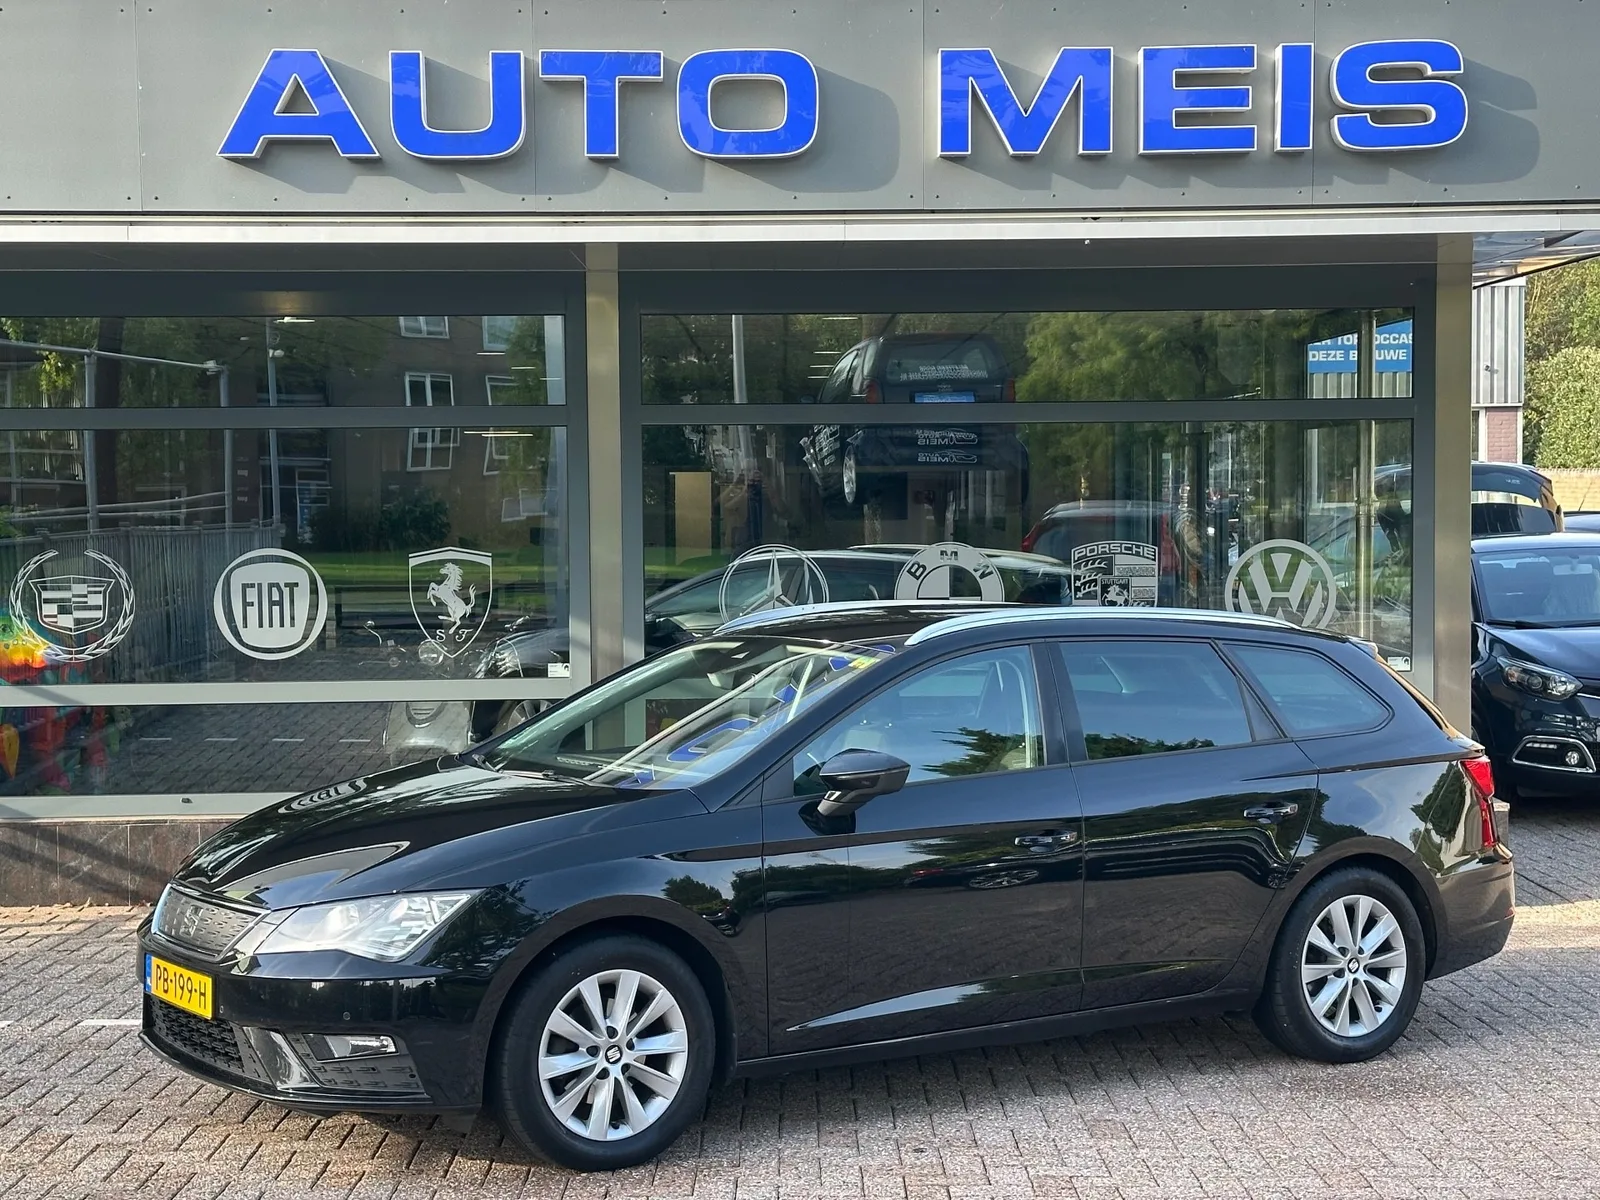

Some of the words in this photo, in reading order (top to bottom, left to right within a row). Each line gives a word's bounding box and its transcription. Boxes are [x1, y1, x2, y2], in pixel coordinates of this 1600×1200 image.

[215, 47, 820, 160] AUTO
[936, 38, 1469, 157] MEIS
[1309, 350, 1344, 361] DEZE
[1074, 542, 1156, 561] PORSCHE
[241, 582, 299, 629] FIAT
[155, 963, 207, 1010] PB-199-H
